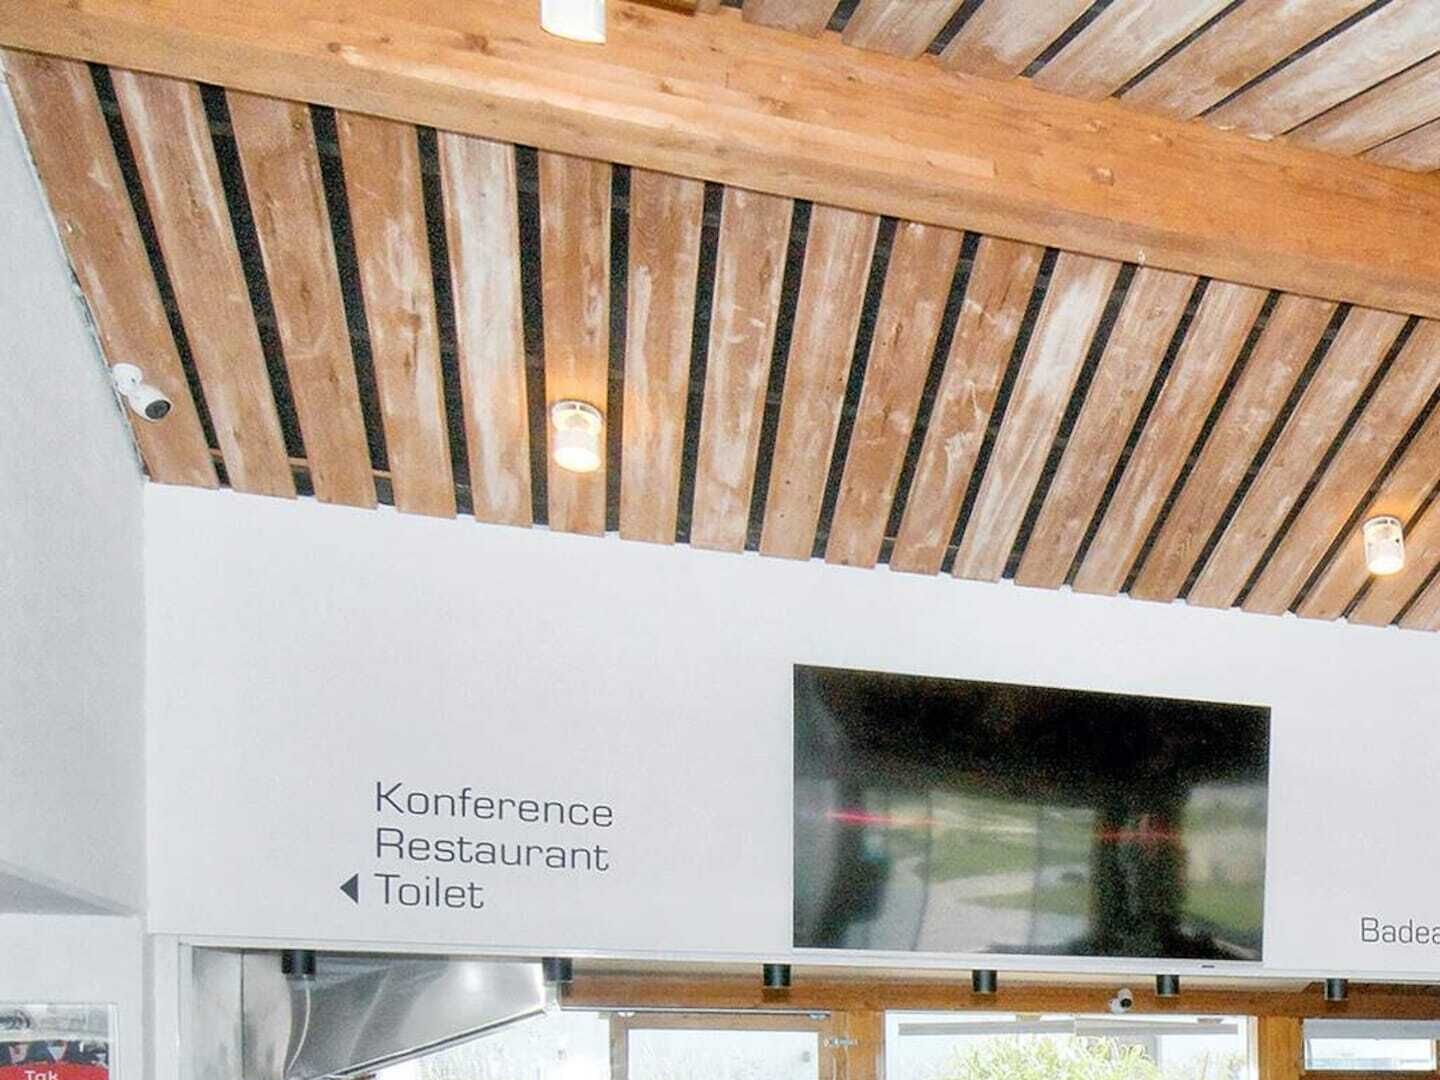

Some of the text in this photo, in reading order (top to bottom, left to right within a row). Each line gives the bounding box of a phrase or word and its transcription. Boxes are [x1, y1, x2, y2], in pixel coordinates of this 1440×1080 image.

[375, 780, 613, 828] Konference
[375, 827, 610, 872] Restaurant
[373, 872, 485, 910] Toilet
